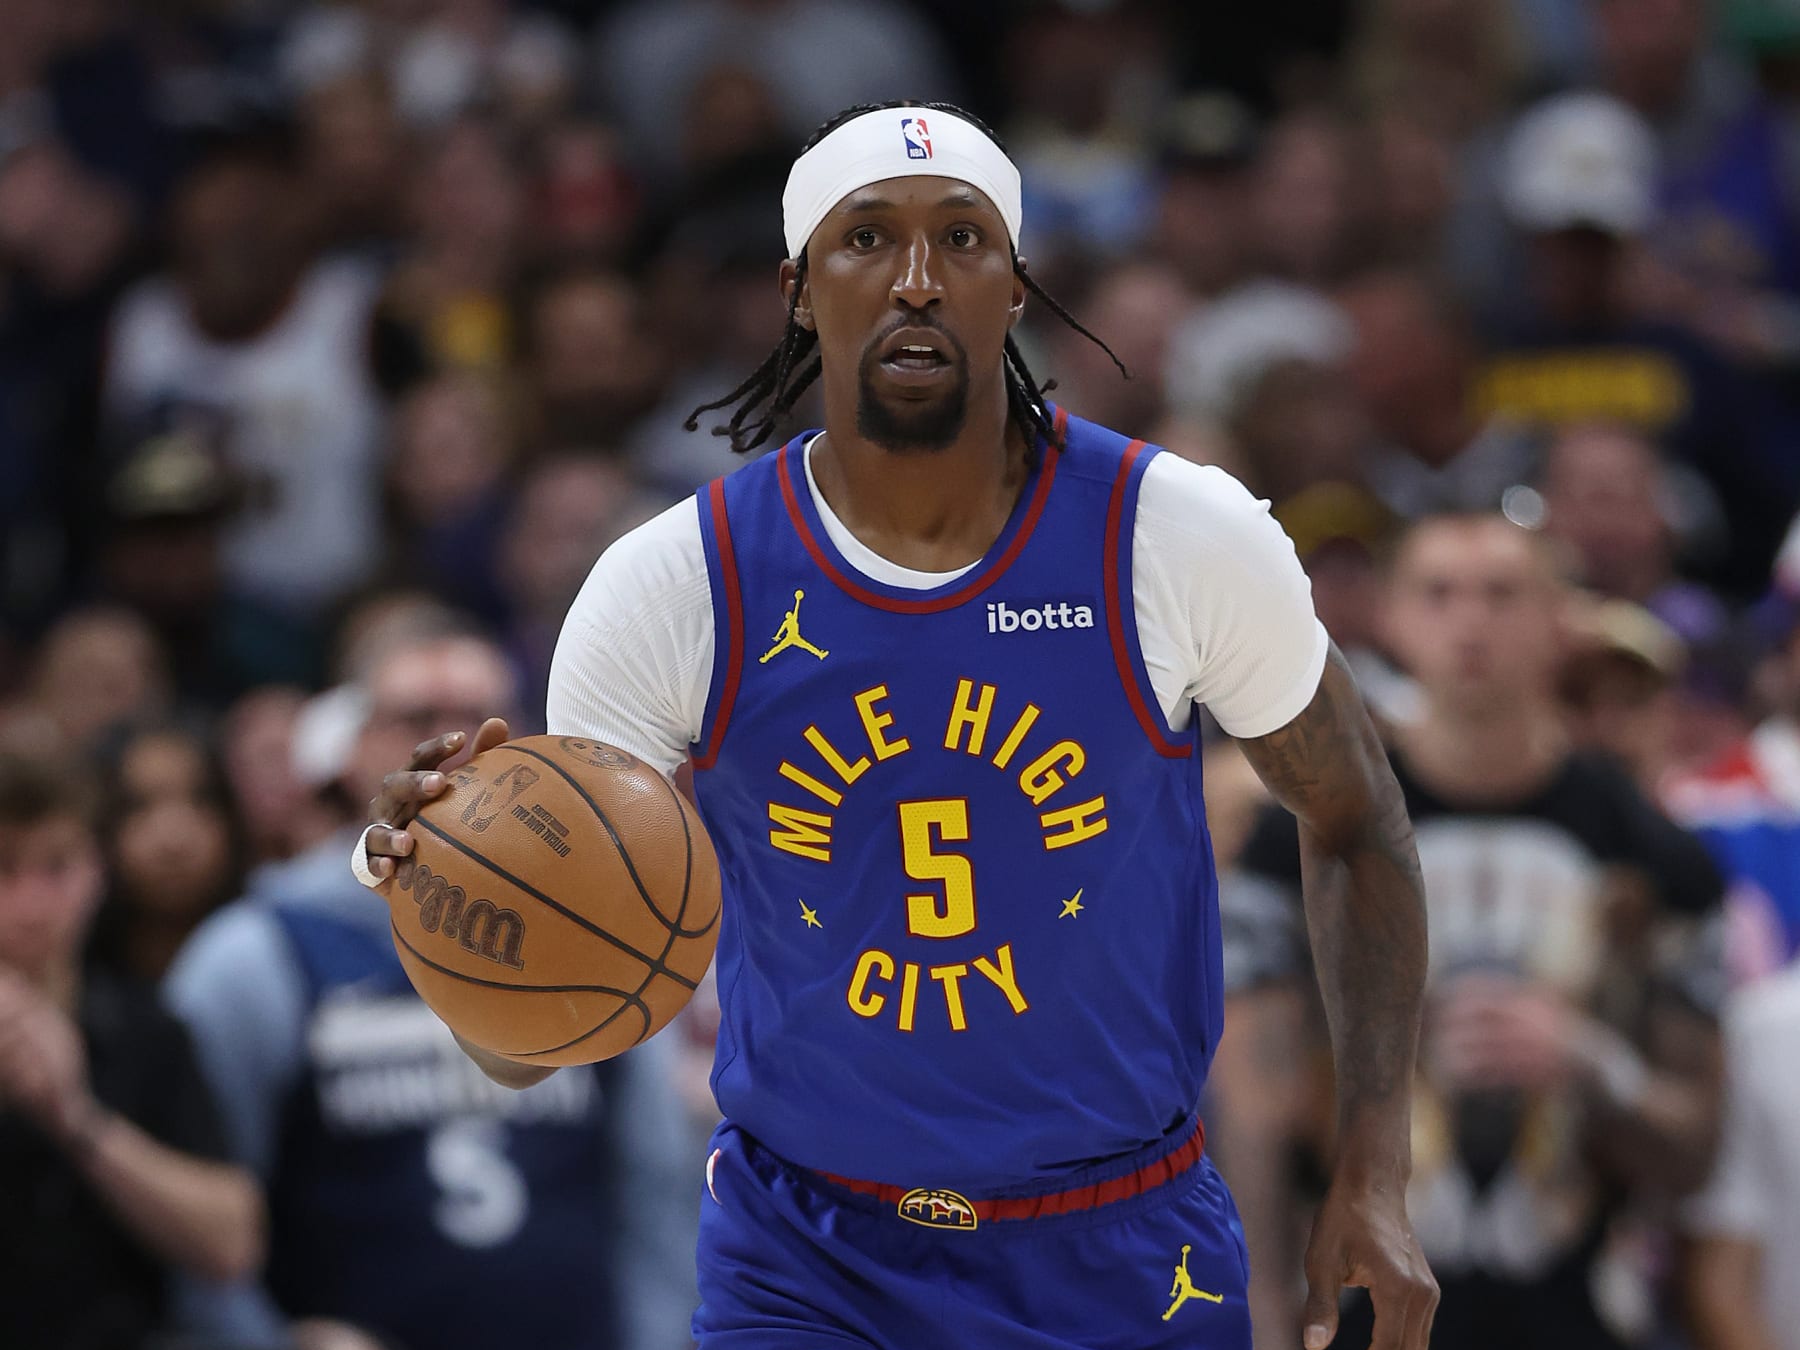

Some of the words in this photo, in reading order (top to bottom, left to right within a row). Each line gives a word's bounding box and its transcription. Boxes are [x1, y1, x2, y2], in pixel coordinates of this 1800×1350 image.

[987, 601, 1094, 634] ibotta
[767, 683, 911, 864] MILE
[943, 676, 1109, 851] HIGH
[897, 796, 978, 939] 5
[847, 943, 1031, 1032] CITY
